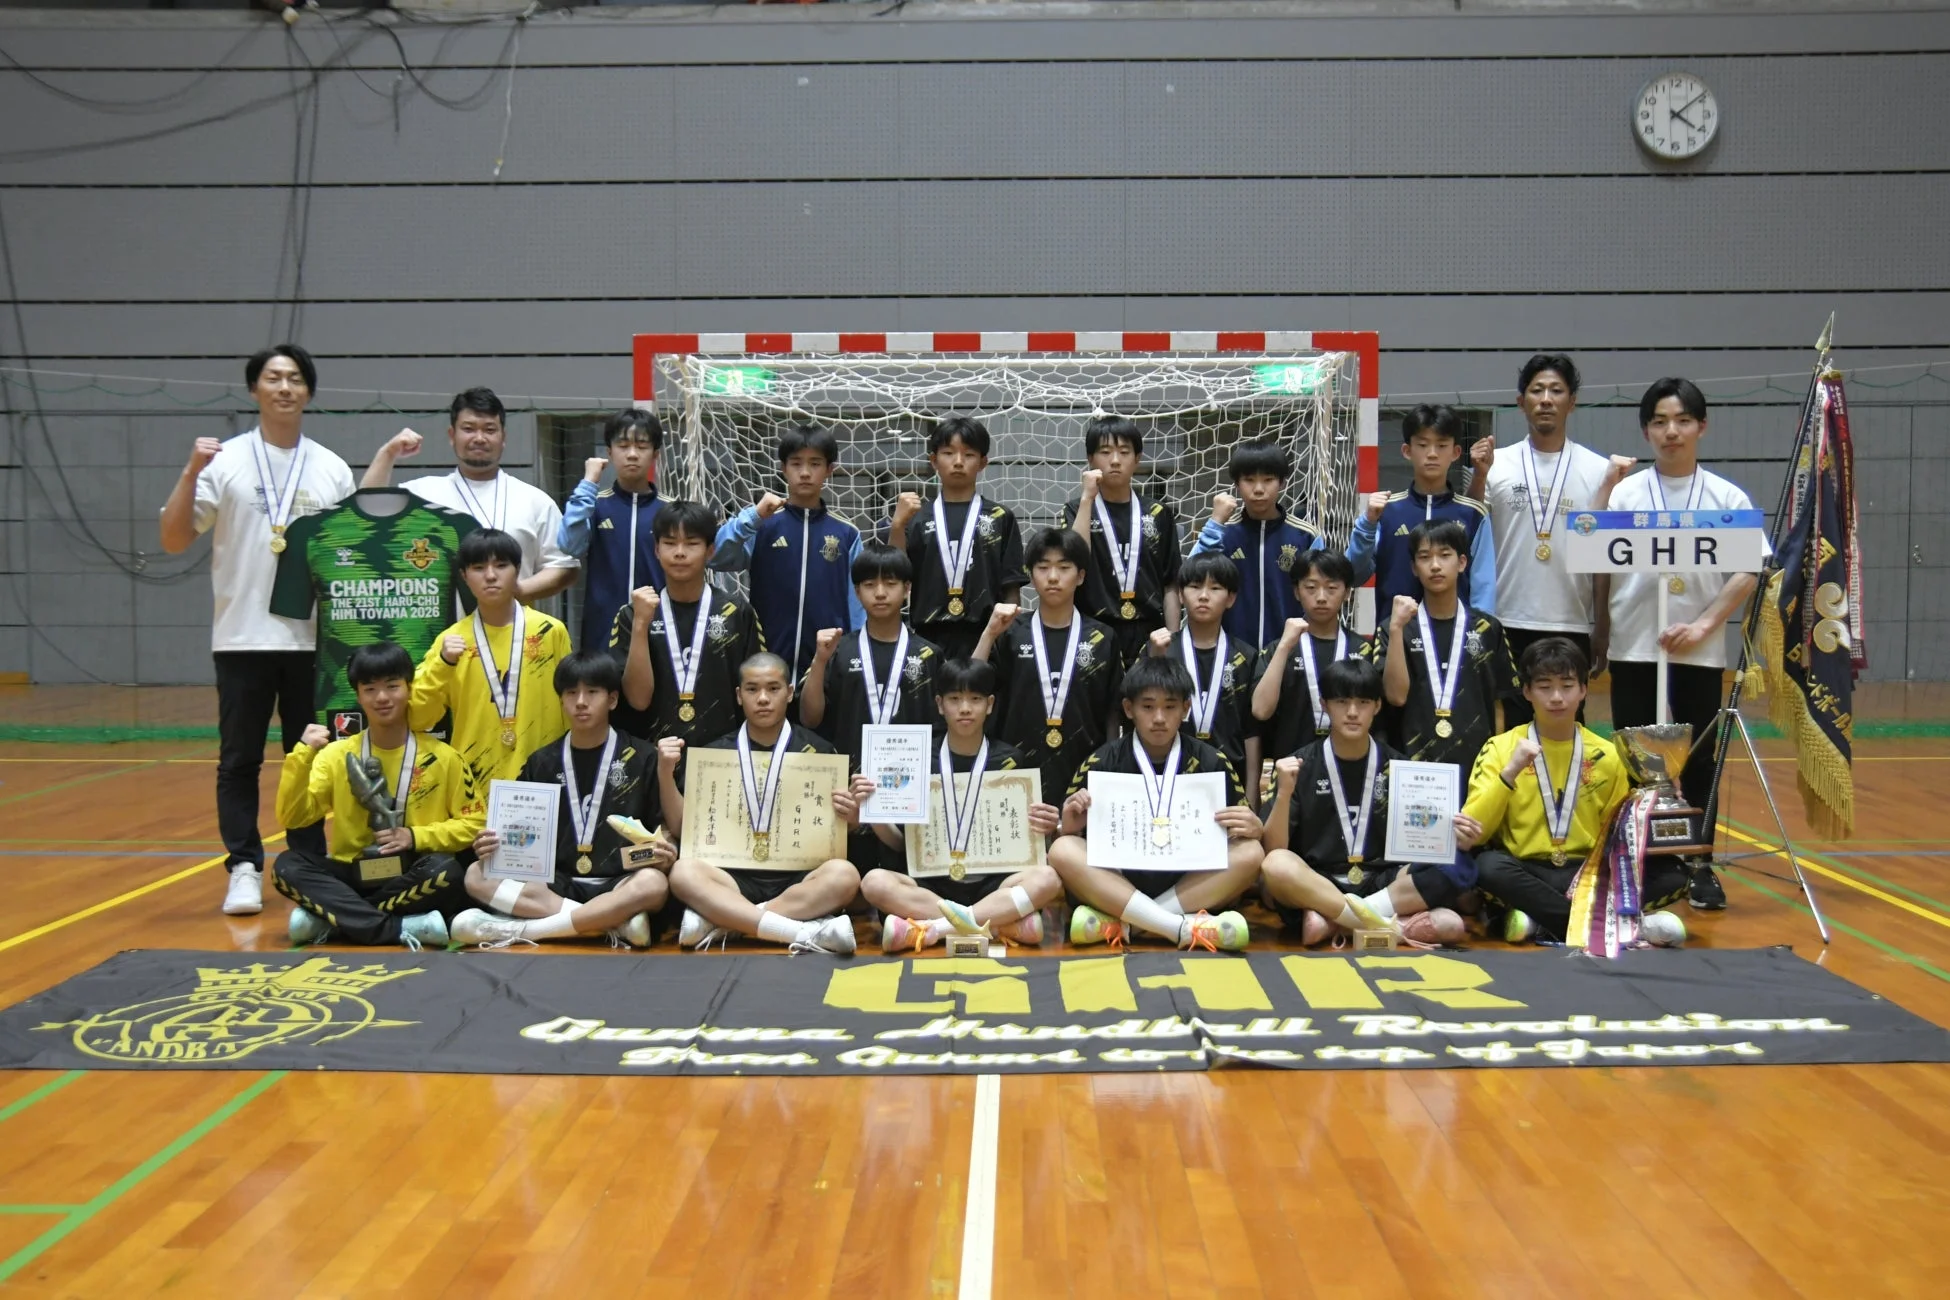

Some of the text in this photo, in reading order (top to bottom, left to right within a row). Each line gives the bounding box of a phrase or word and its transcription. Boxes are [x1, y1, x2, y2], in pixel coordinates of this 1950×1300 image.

[1655, 84, 1665, 93] 11
[1671, 79, 1682, 88] 12
[1645, 96, 1657, 105] 10
[1633, 512, 1695, 528] 群馬県
[1607, 536, 1718, 566] GHR
[330, 577, 440, 598] CHAMPIONS
[331, 595, 440, 609] THE 21ST HARU-CHU
[331, 606, 440, 621] HIMI TOYAMA 2026
[823, 955, 1528, 1014] GHR
[520, 1012, 1850, 1043] Gunma Handball Revolution
[1313, 1045, 1436, 1064] top
[1445, 1041, 1526, 1062] of
